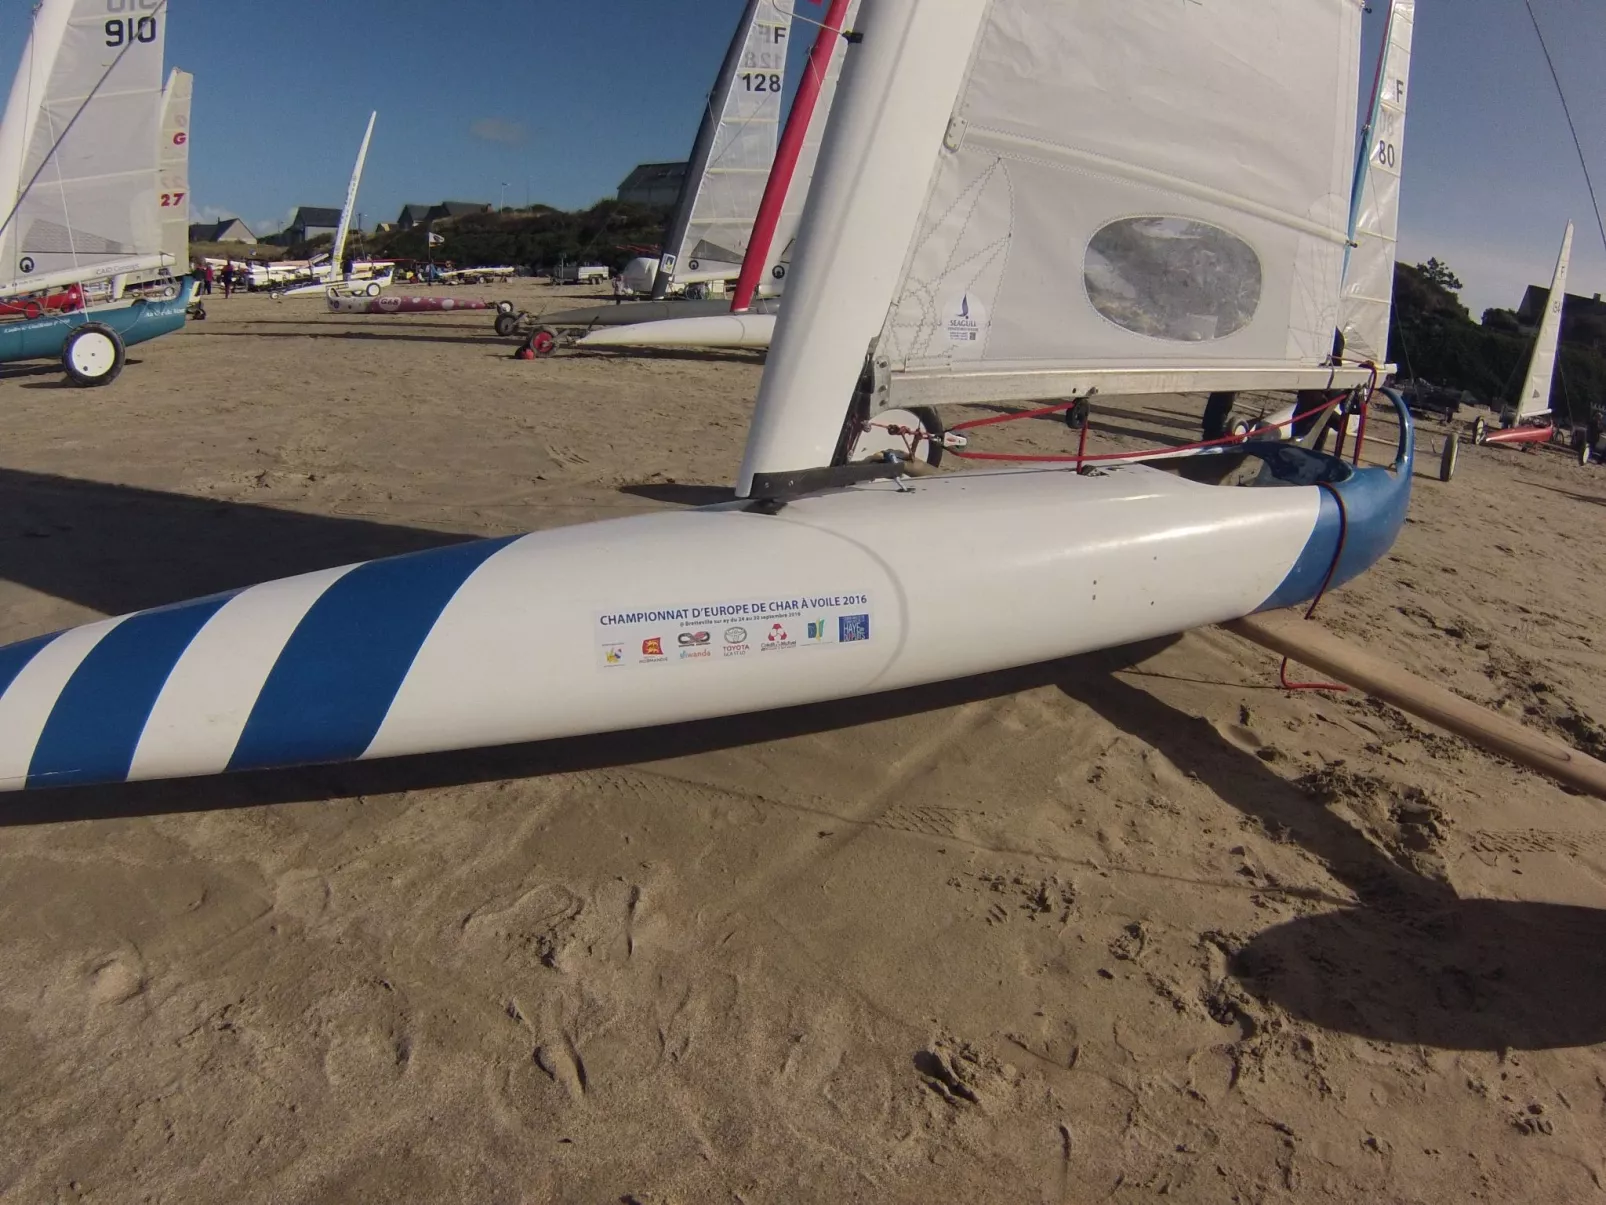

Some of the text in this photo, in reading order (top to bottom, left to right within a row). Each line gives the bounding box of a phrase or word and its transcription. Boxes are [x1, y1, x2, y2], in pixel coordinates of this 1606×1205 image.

[105, 16, 156, 47] 910
[774, 26, 787, 45] F
[742, 72, 782, 93] 128
[1396, 79, 1404, 103] F
[173, 132, 187, 146] G
[1378, 140, 1395, 168] 80
[160, 192, 185, 207] 27
[600, 594, 868, 625] CHAMPIONNAT D'EUROPE DE CHAR À VOILE 2016
[723, 643, 750, 652] TOYOTA
